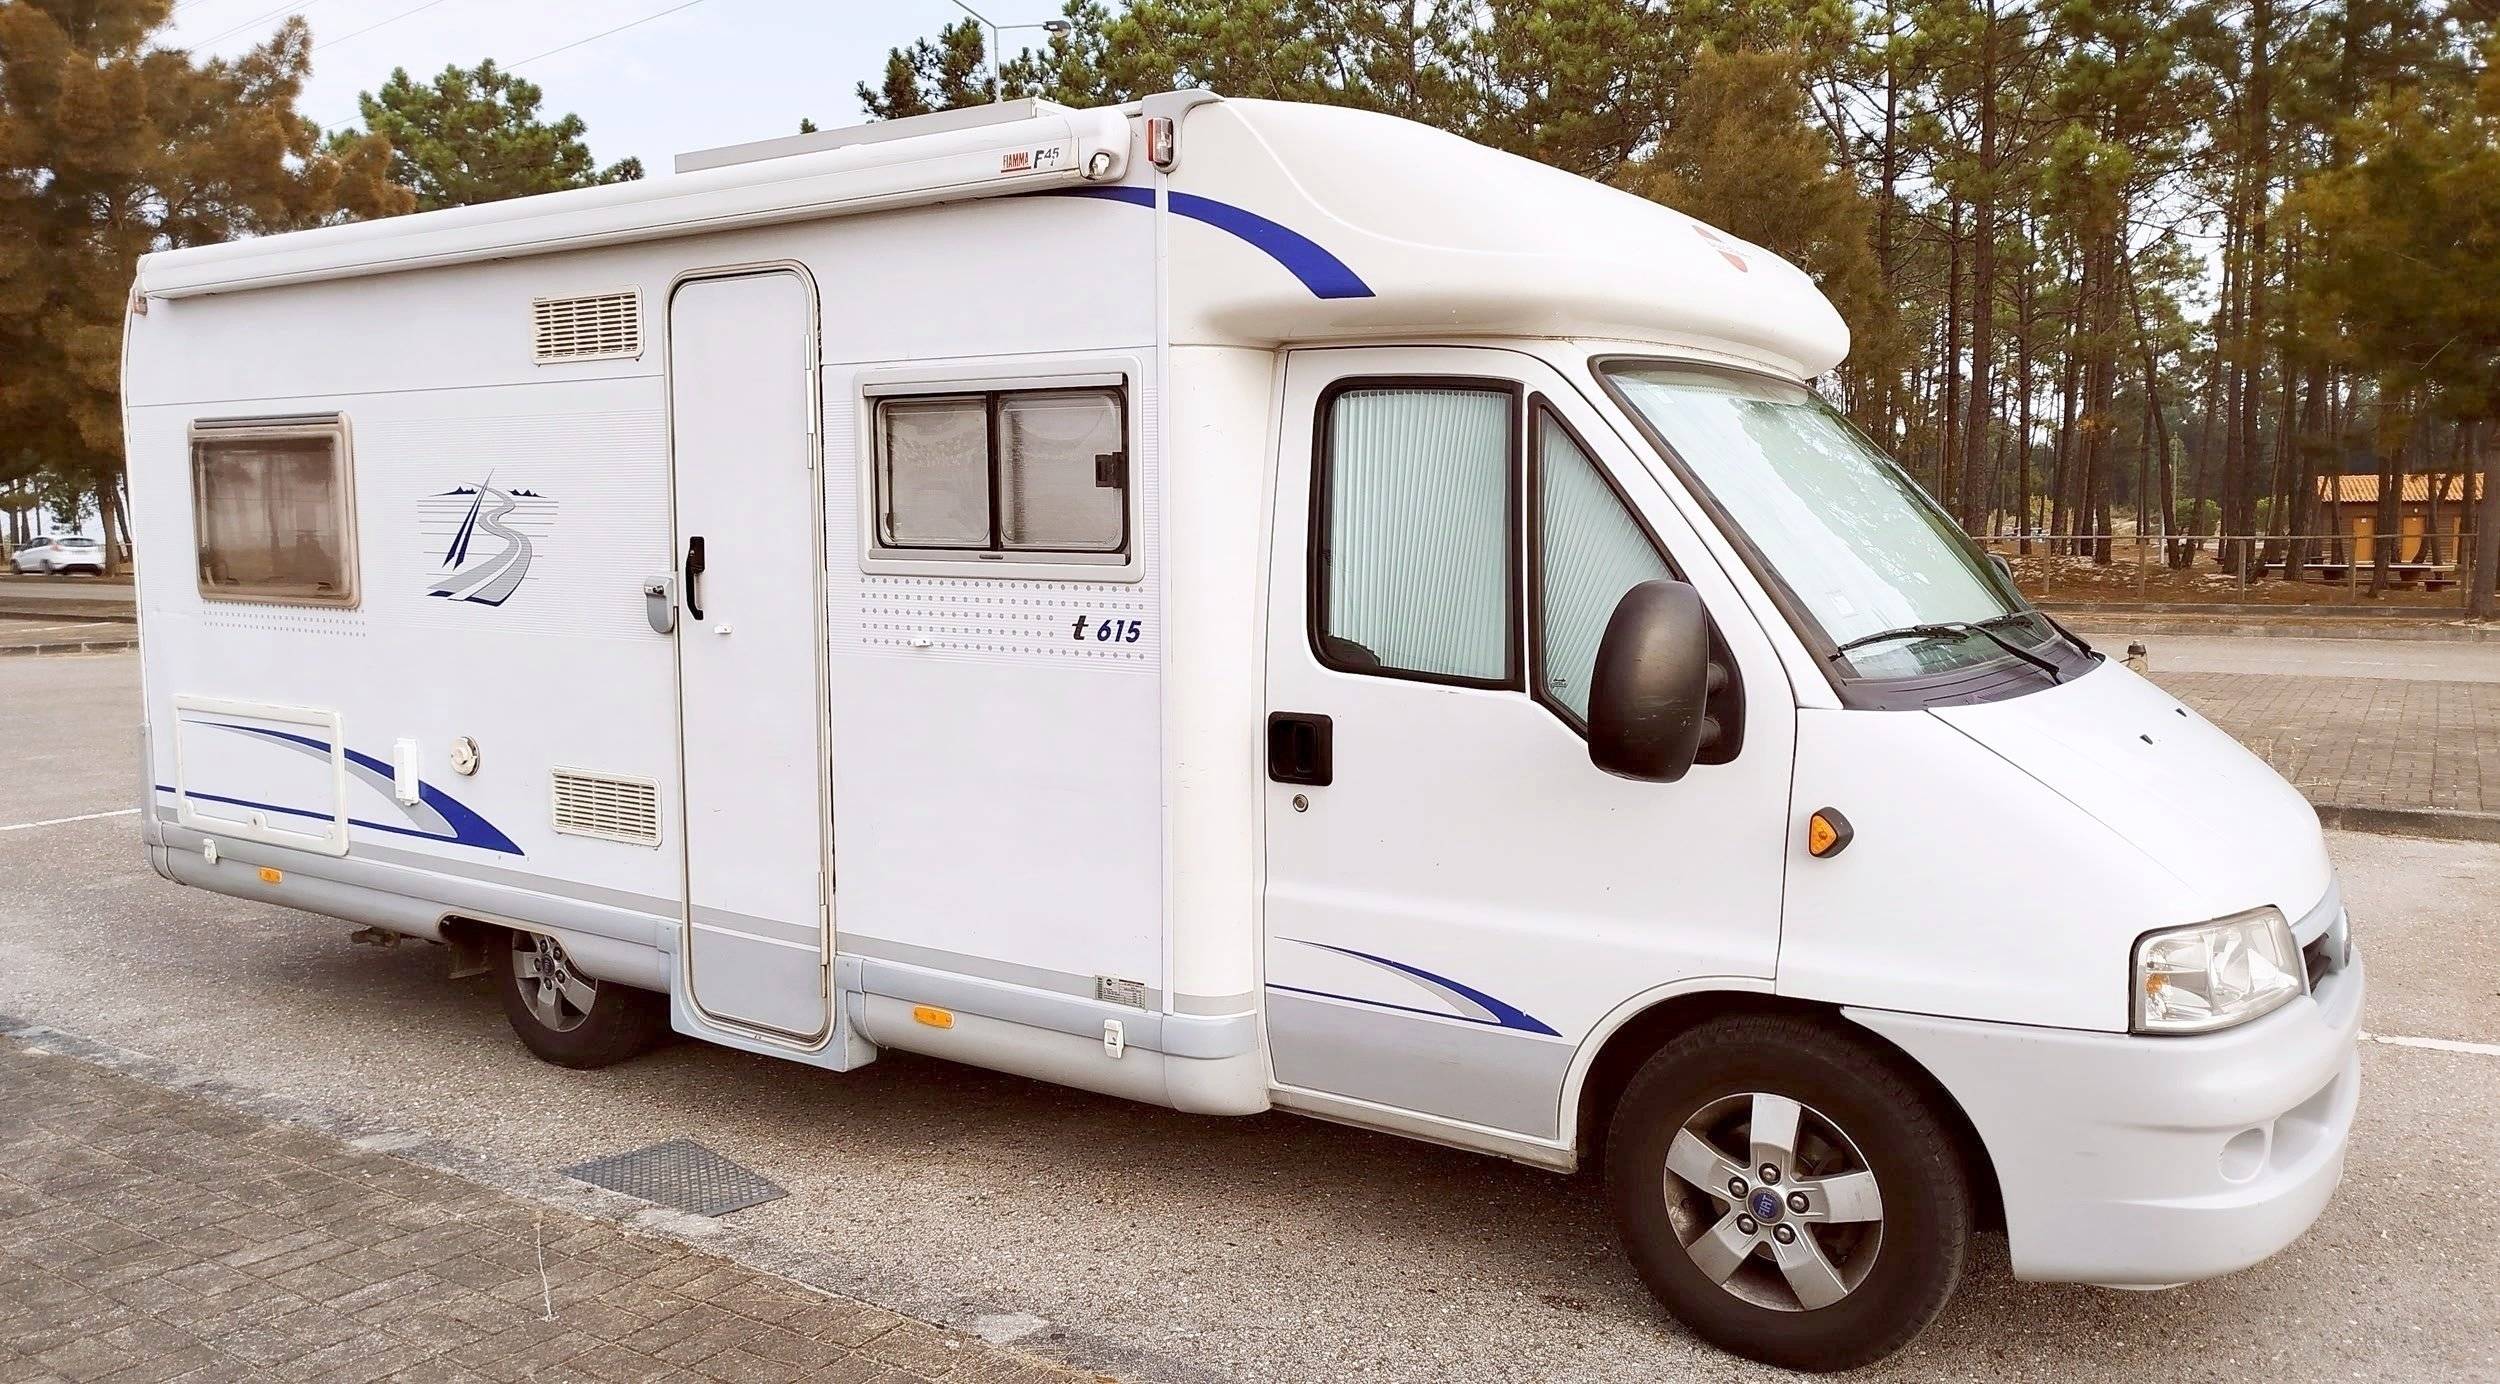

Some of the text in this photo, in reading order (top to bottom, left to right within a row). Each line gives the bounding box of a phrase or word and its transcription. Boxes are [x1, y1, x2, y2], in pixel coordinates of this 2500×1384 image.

[1003, 152, 1029, 168] FIAMMA
[1072, 615, 1142, 643] t 615
[1758, 1194, 1774, 1217] FIAT
